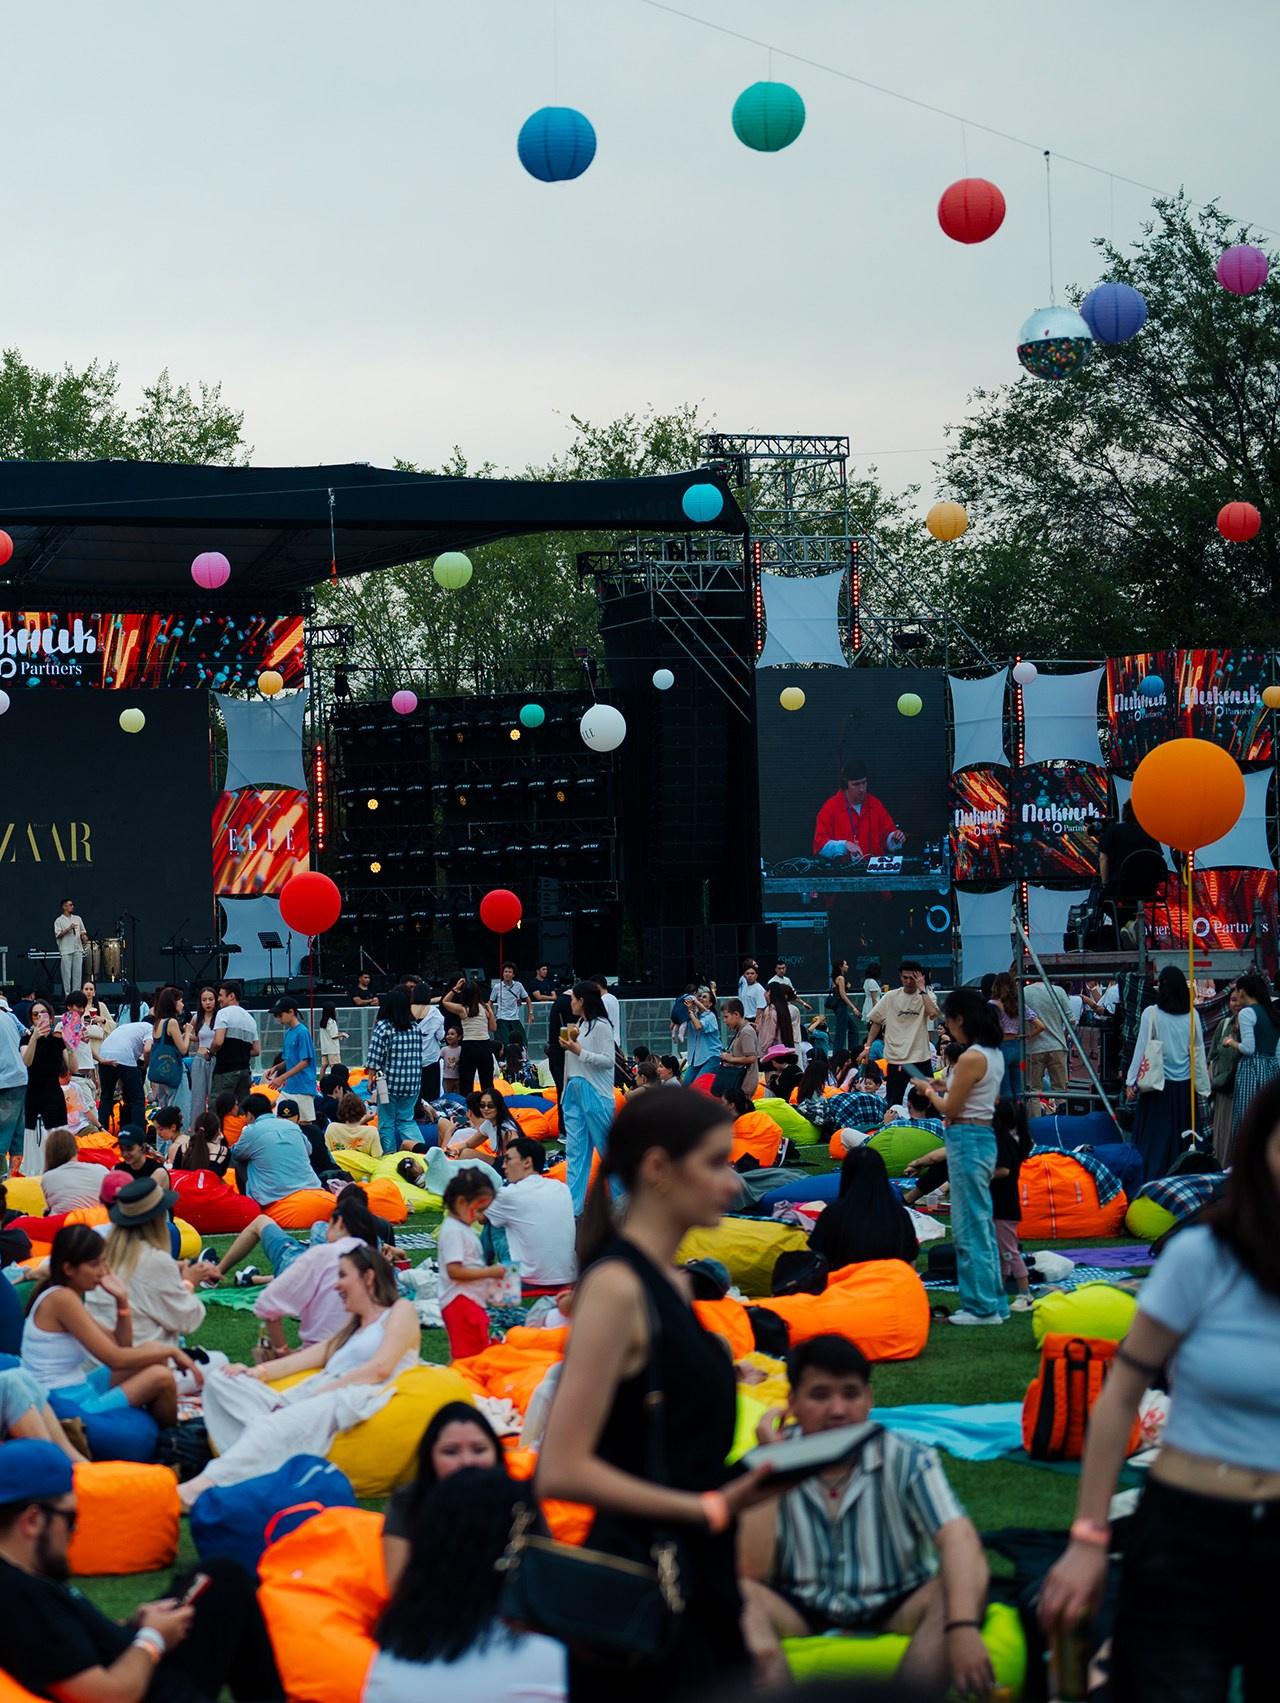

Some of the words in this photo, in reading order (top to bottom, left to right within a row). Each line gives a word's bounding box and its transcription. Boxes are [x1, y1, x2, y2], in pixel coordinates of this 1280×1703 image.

[21, 663, 82, 675] Partners
[229, 827, 295, 851] ELLE
[1214, 921, 1269, 933] Partns
